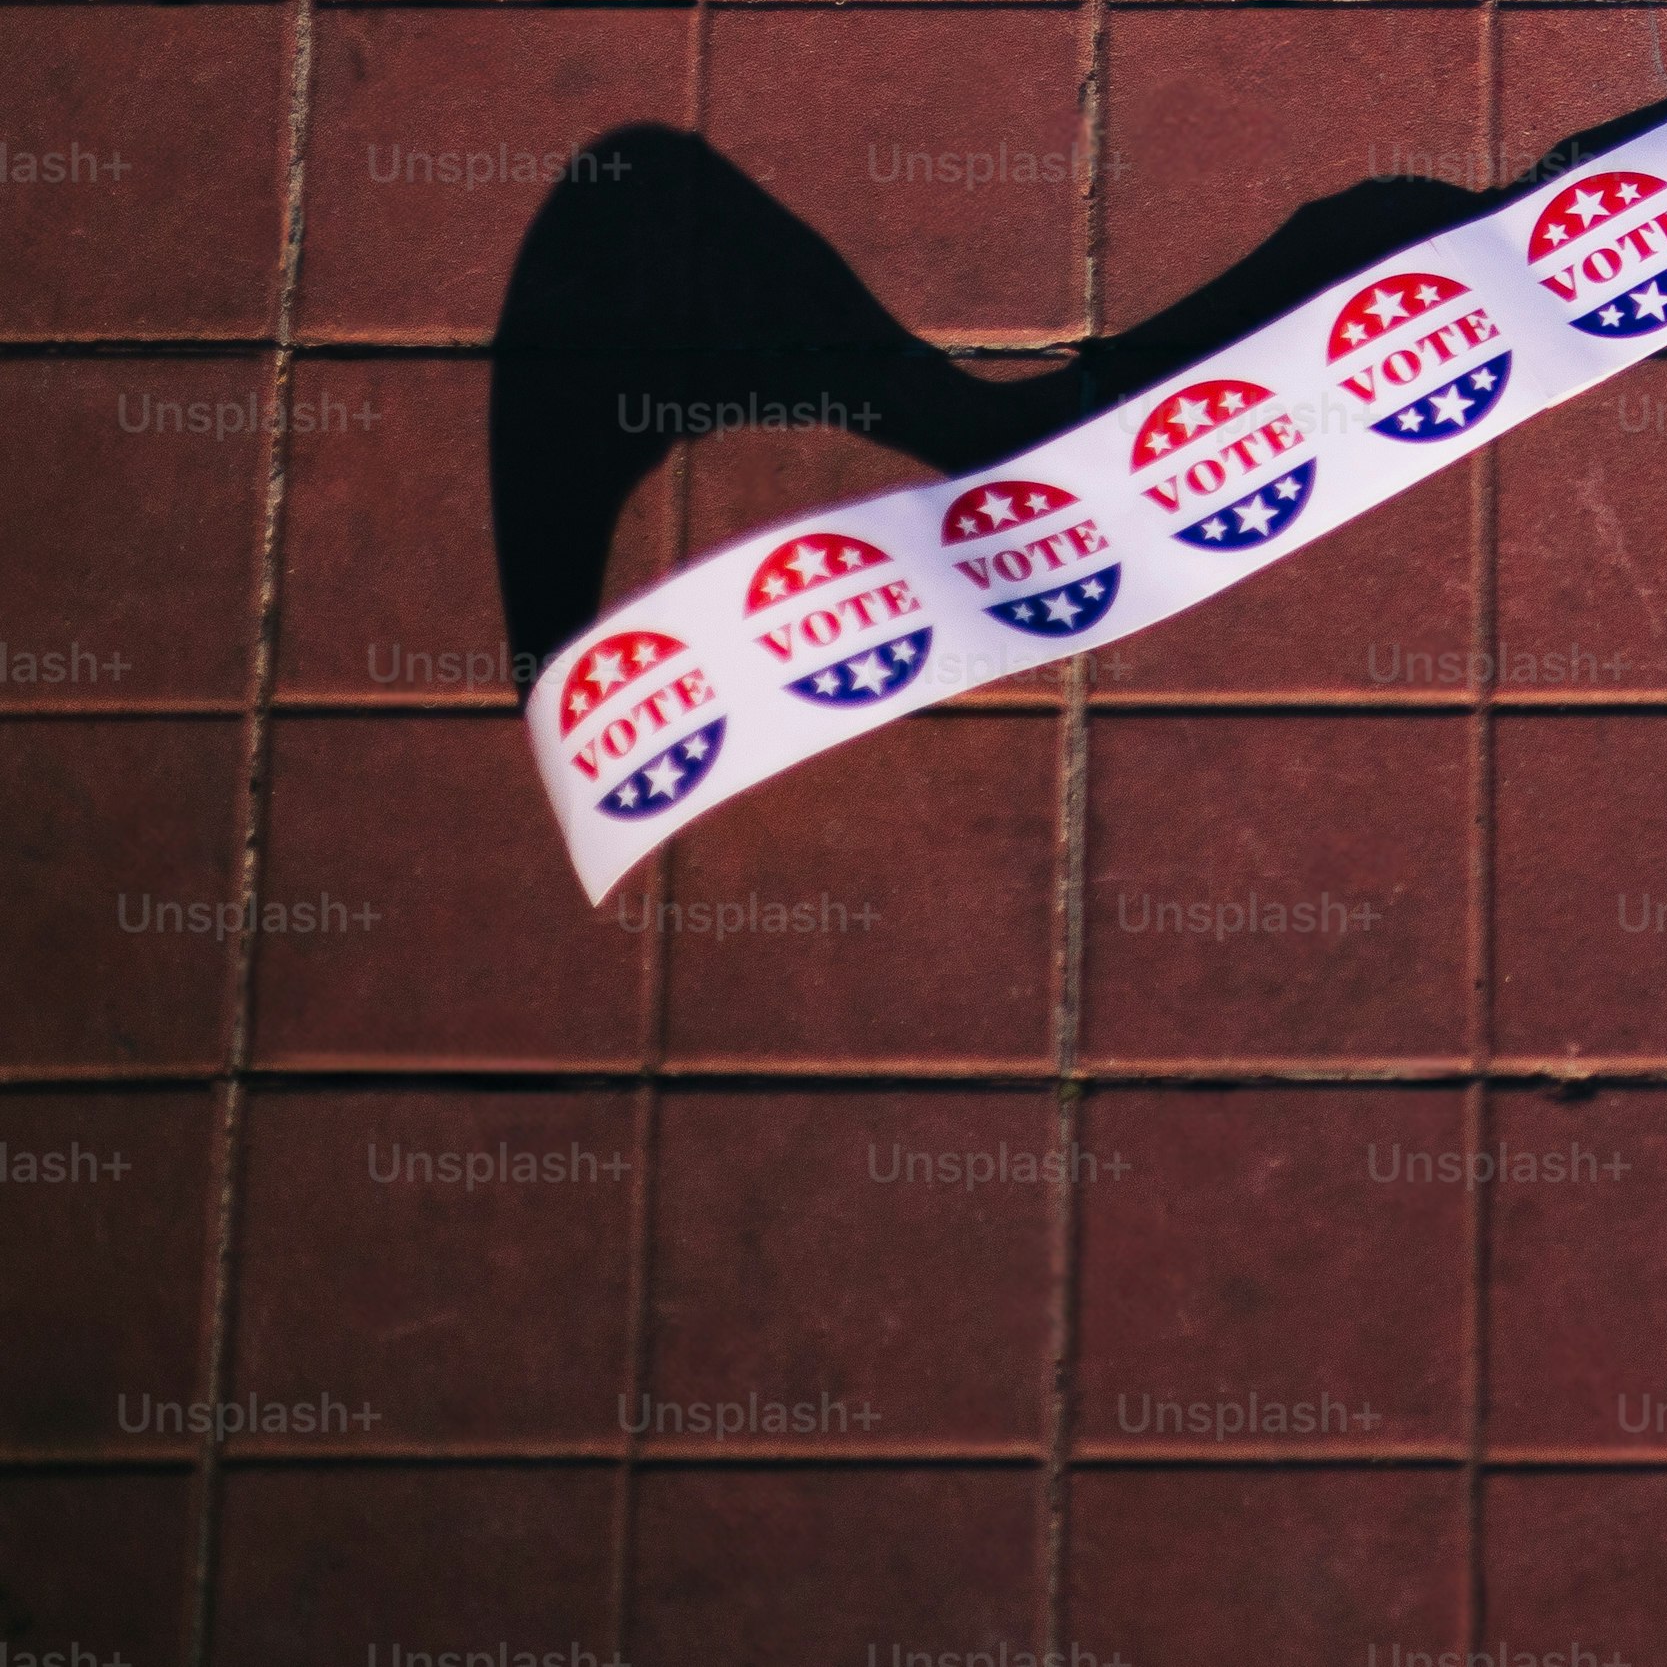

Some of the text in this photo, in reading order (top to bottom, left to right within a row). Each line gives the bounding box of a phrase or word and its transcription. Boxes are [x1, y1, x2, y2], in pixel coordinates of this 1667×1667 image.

[1337, 308, 1499, 404] VOTE
[1140, 414, 1306, 516] VOTE
[953, 519, 1109, 590] VOTE
[754, 580, 921, 665] VOTE
[570, 669, 716, 782] VOTE
